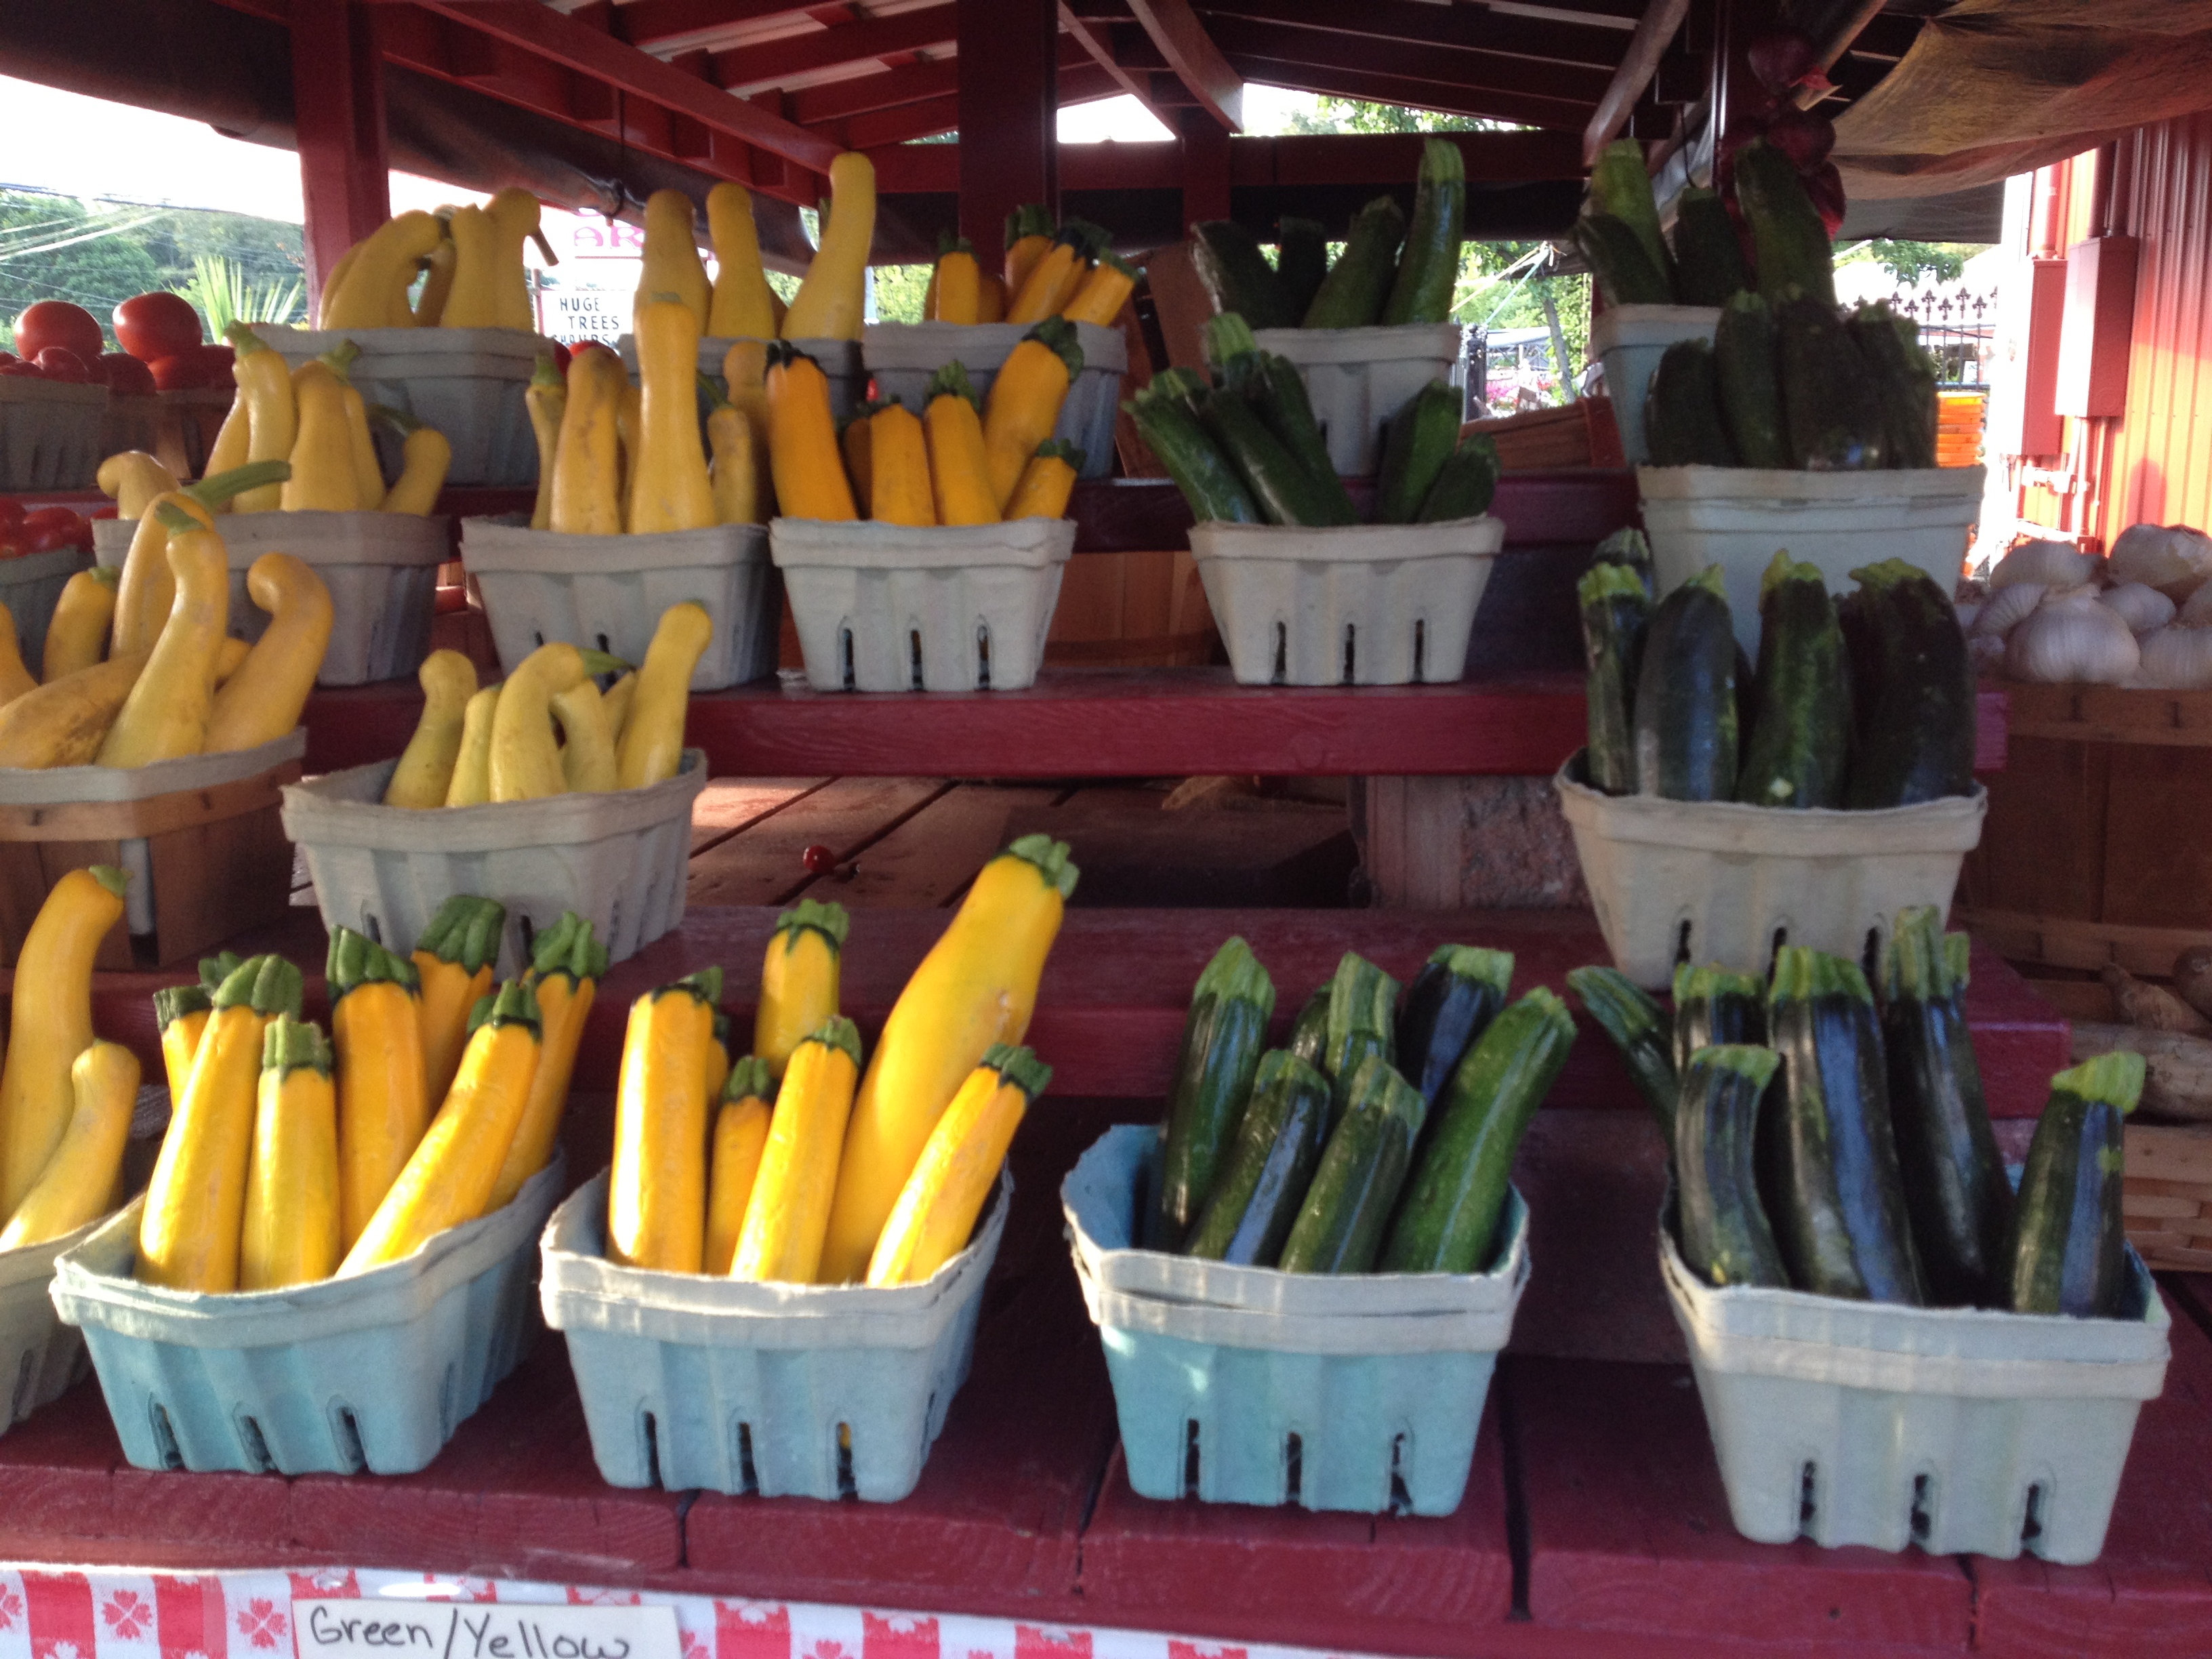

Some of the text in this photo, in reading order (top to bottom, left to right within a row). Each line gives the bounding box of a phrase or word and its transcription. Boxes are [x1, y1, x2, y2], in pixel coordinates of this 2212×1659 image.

[560, 298, 600, 312] HUGE
[568, 316, 619, 330] TREES
[310, 1605, 630, 1659] Green/Yellow
